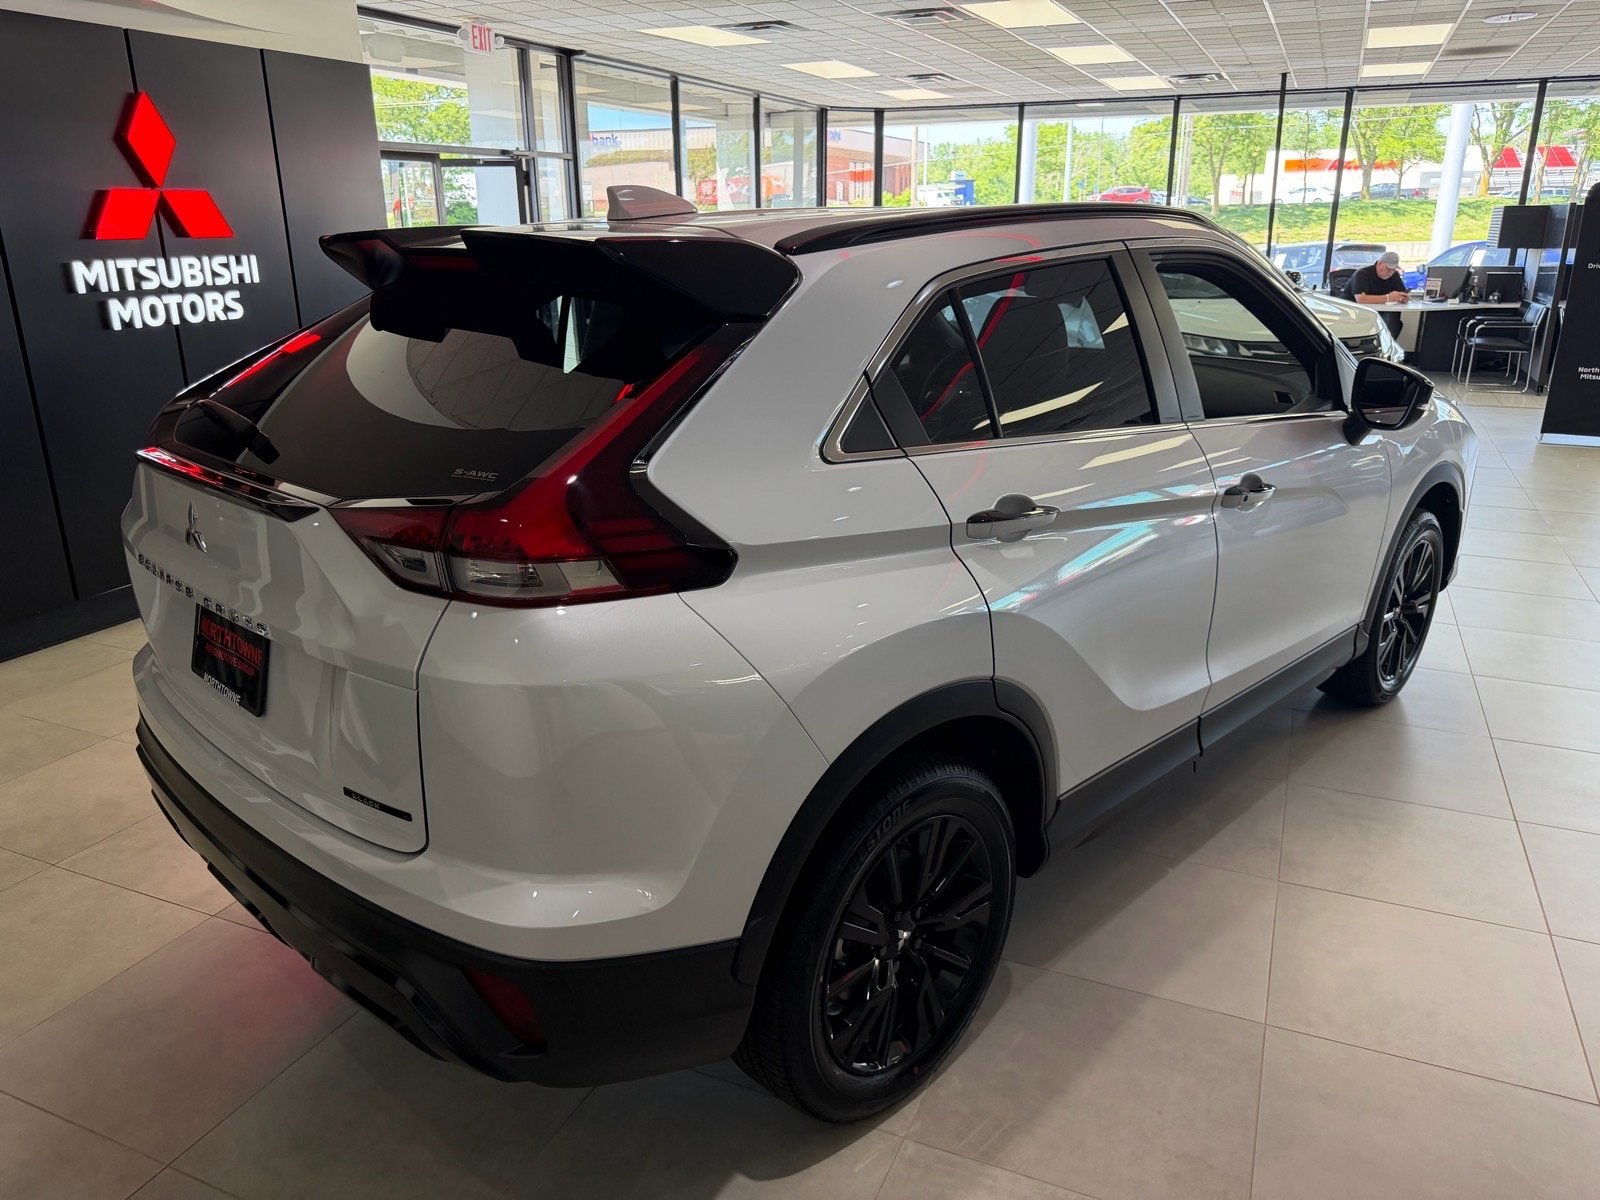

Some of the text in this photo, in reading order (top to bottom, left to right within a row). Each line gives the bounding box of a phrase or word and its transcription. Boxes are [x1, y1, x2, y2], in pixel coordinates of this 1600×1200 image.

[471, 24, 491, 52] EXIT
[71, 254, 260, 294] MITSUBISHI
[107, 290, 244, 331] MOTORS
[453, 468, 499, 480] S-AWC
[203, 597, 268, 636] CROSS
[201, 614, 264, 668] NORTHTOWNE
[203, 672, 241, 706] NORTHTOWNE
